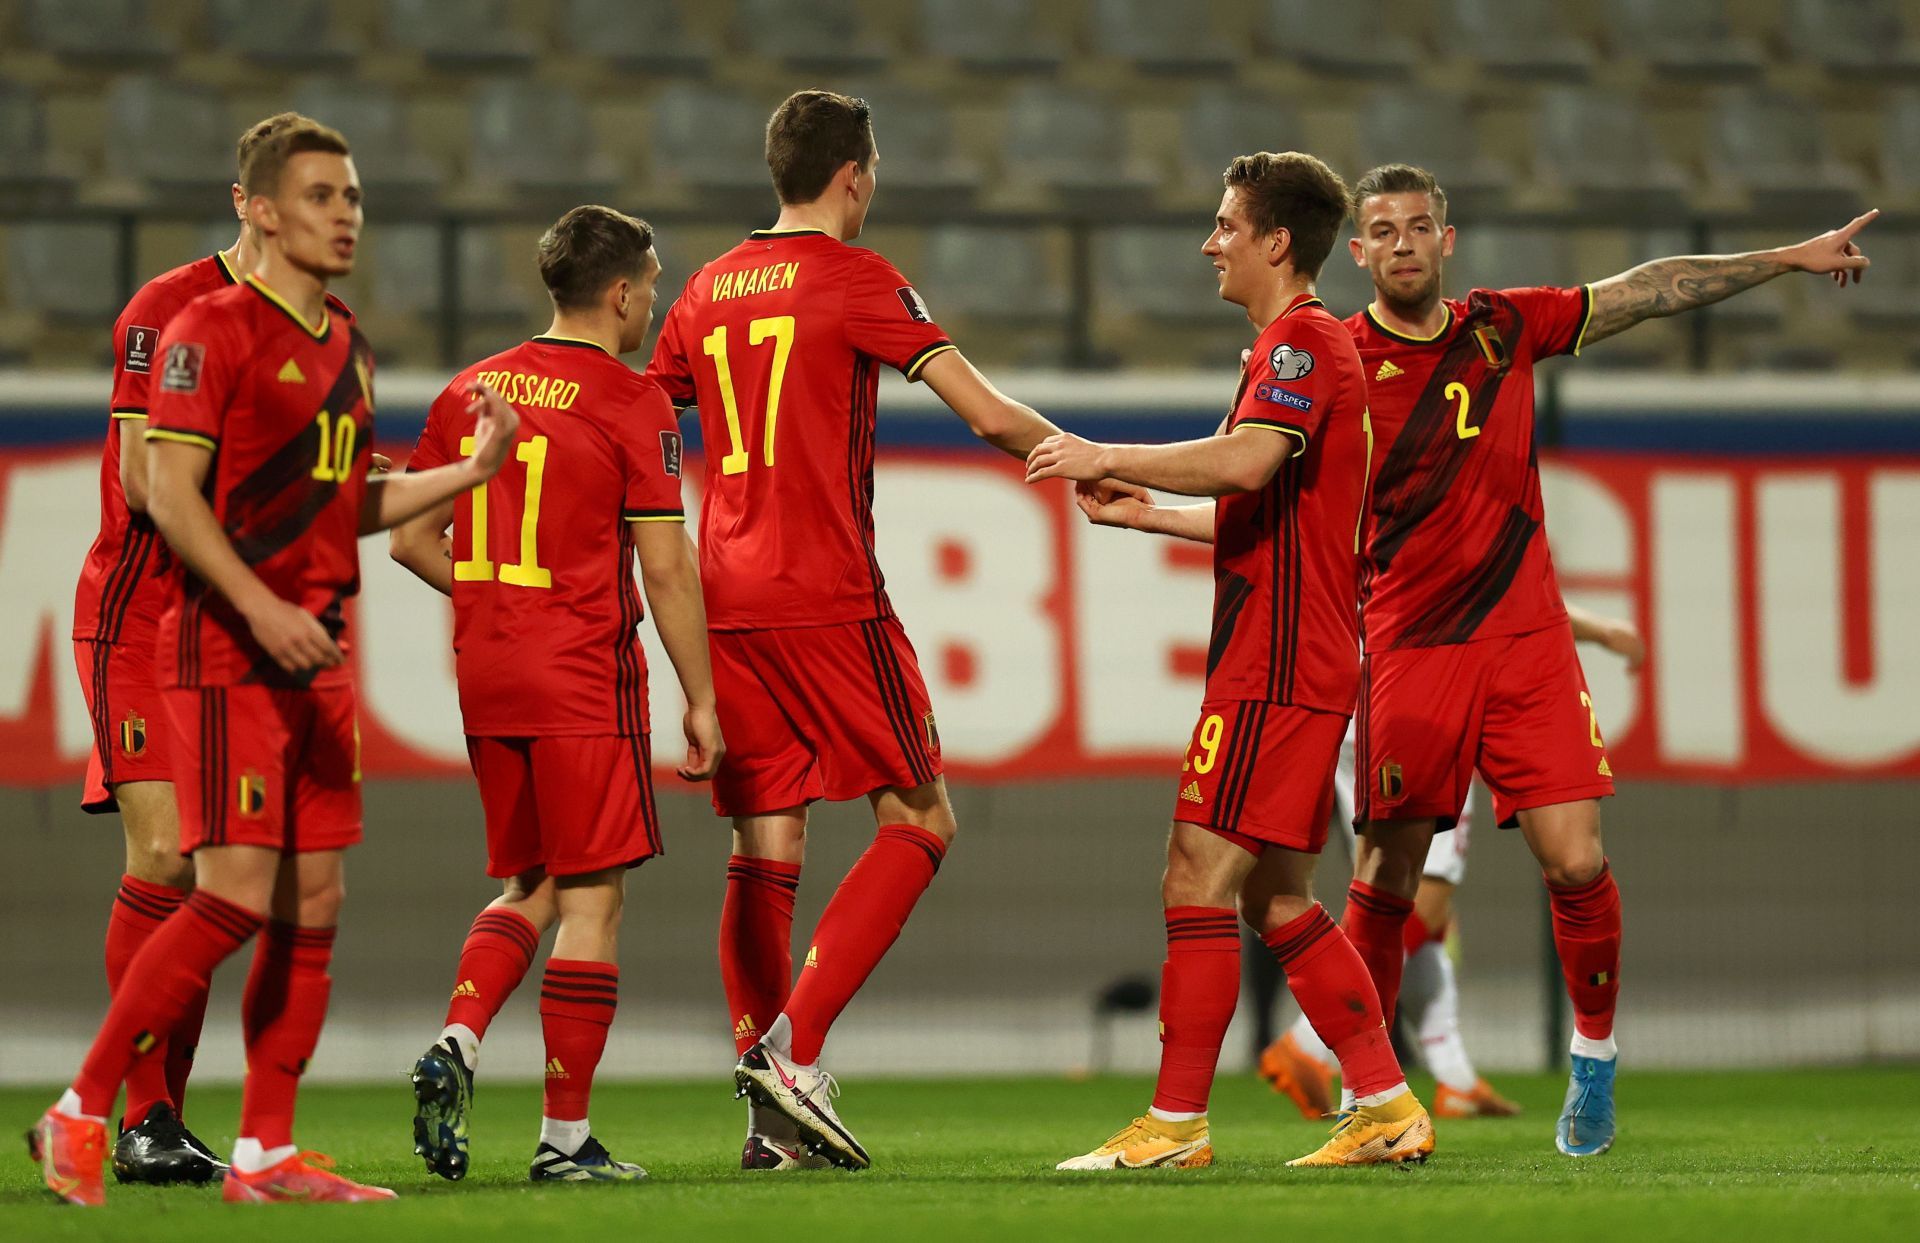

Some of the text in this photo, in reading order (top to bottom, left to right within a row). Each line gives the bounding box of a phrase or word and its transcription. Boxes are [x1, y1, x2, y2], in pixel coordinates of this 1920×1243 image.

[712, 262, 800, 302] VANAKEN
[703, 316, 796, 475] 17
[1270, 391, 1312, 410] RESPECT
[1444, 382, 1481, 440] 2
[311, 410, 357, 484] 10
[453, 435, 552, 588] 11
[1182, 714, 1224, 775] 9
